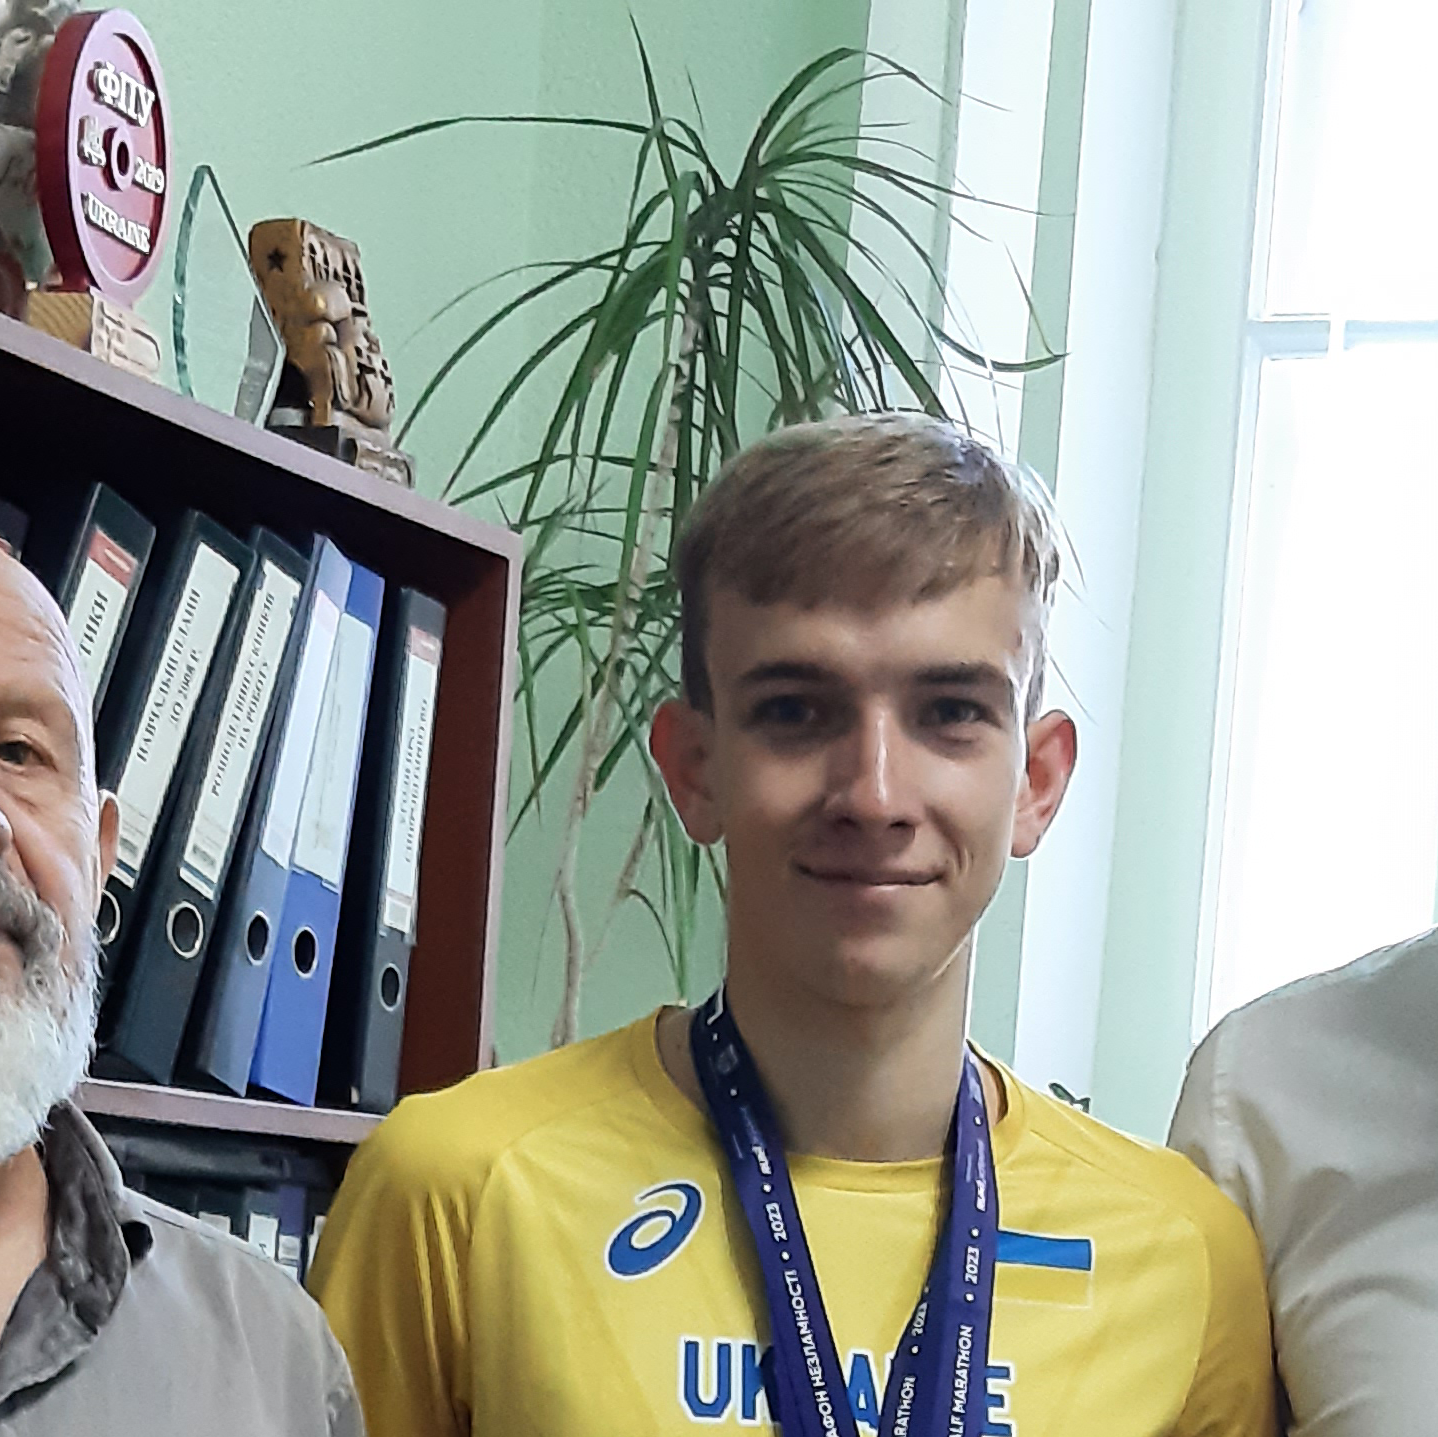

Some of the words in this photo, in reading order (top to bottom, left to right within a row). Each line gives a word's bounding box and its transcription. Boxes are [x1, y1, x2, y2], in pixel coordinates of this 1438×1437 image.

[81, 193, 151, 255] UKRAINE
[784, 1269, 825, 1388] НЕЗЛАМНОСТІ
[953, 1325, 973, 1413] MARATHON
